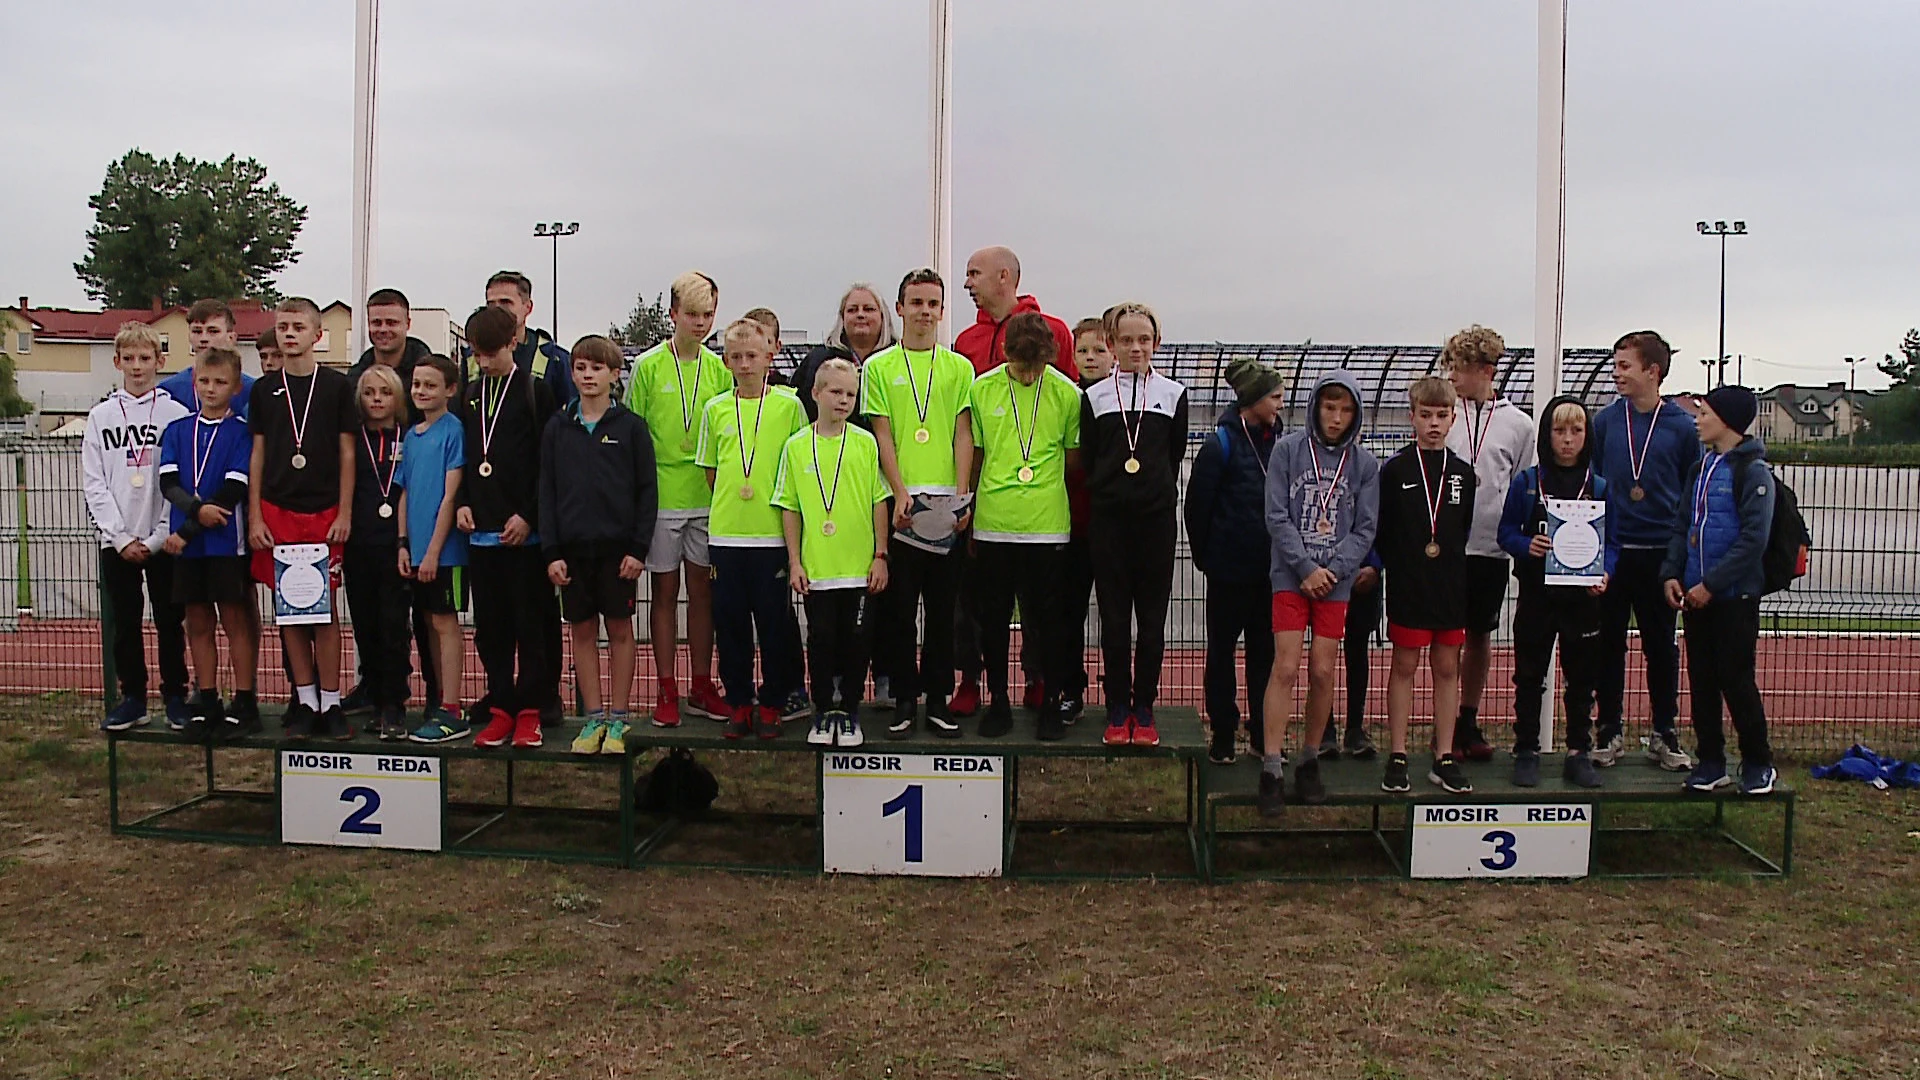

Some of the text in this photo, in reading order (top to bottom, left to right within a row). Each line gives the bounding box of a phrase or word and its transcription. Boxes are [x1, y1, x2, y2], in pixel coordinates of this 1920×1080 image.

[288, 754, 431, 773] MOSIR REDA
[832, 756, 993, 772] MOSIR REDA
[339, 786, 382, 835] 2
[882, 784, 923, 863] 1
[1425, 807, 1587, 822] MOSIR REDA
[1479, 830, 1518, 871] 3
